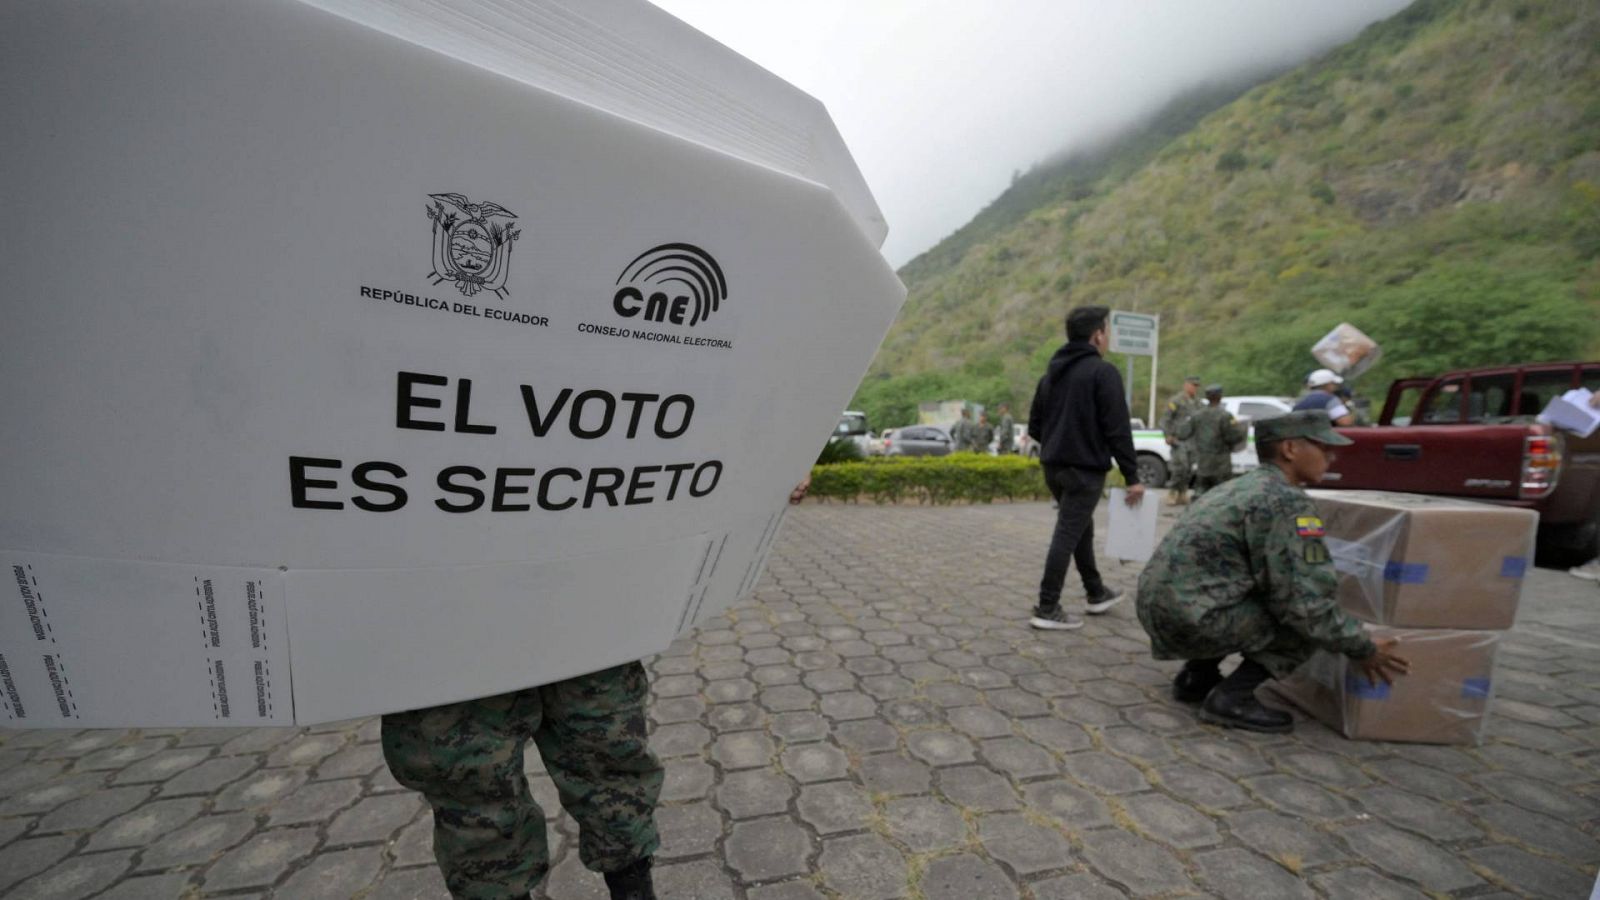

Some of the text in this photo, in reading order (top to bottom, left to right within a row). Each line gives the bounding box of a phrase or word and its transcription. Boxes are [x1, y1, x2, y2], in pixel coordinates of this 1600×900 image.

[360, 286, 548, 326] REPÚBLICA DEL ECUADOR
[578, 324, 733, 348] CONSEJO NACIONAL ELECTORAL
[397, 372, 694, 439] EL VOTO
[289, 456, 722, 513] ES SECRETO
